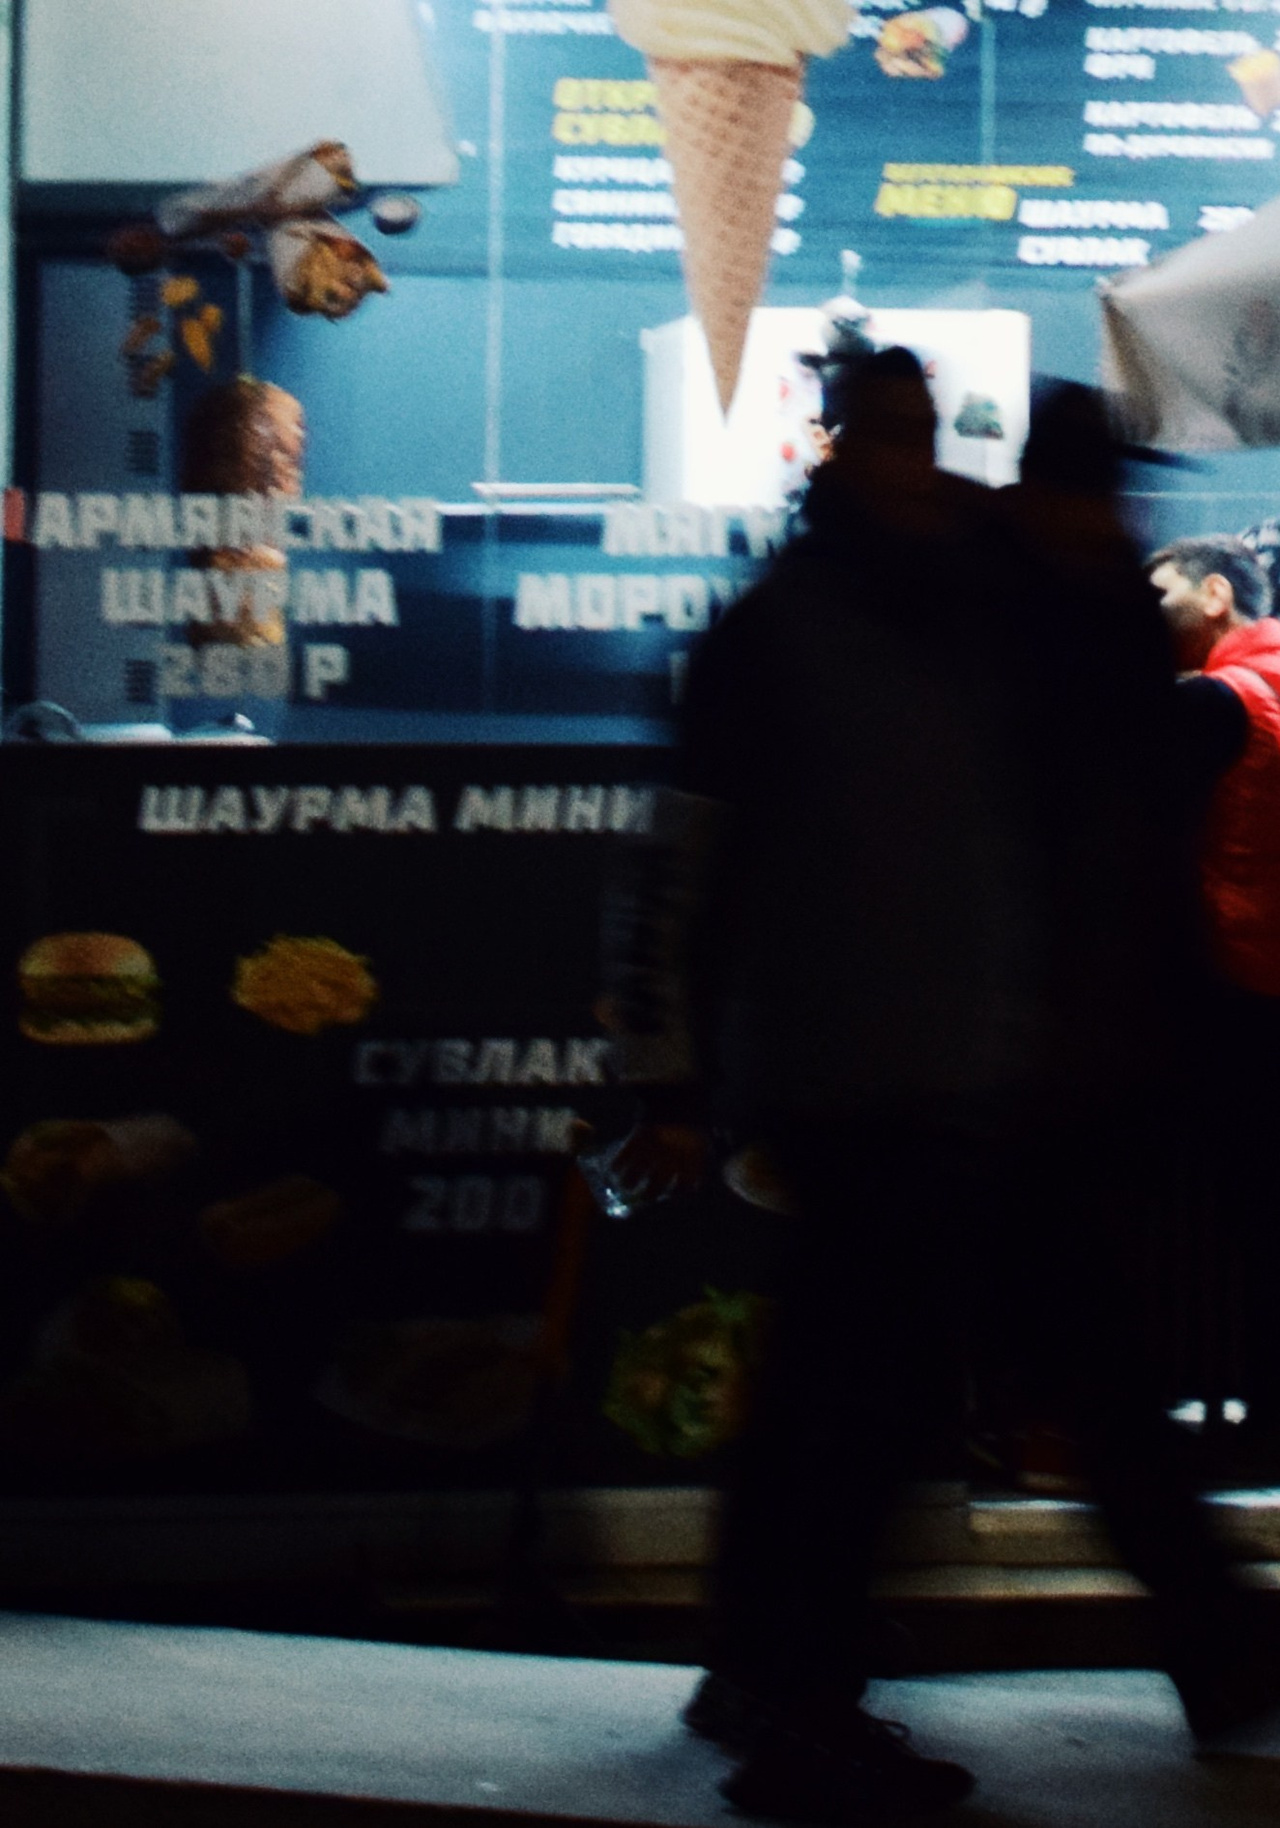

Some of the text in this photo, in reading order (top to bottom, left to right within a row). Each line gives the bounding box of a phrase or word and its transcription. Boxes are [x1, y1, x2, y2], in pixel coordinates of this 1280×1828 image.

[34, 493, 443, 553] АРМЯНСКАЯ
[102, 568, 399, 626] ШАУРМА
[138, 786, 437, 833] ШАУРМА
